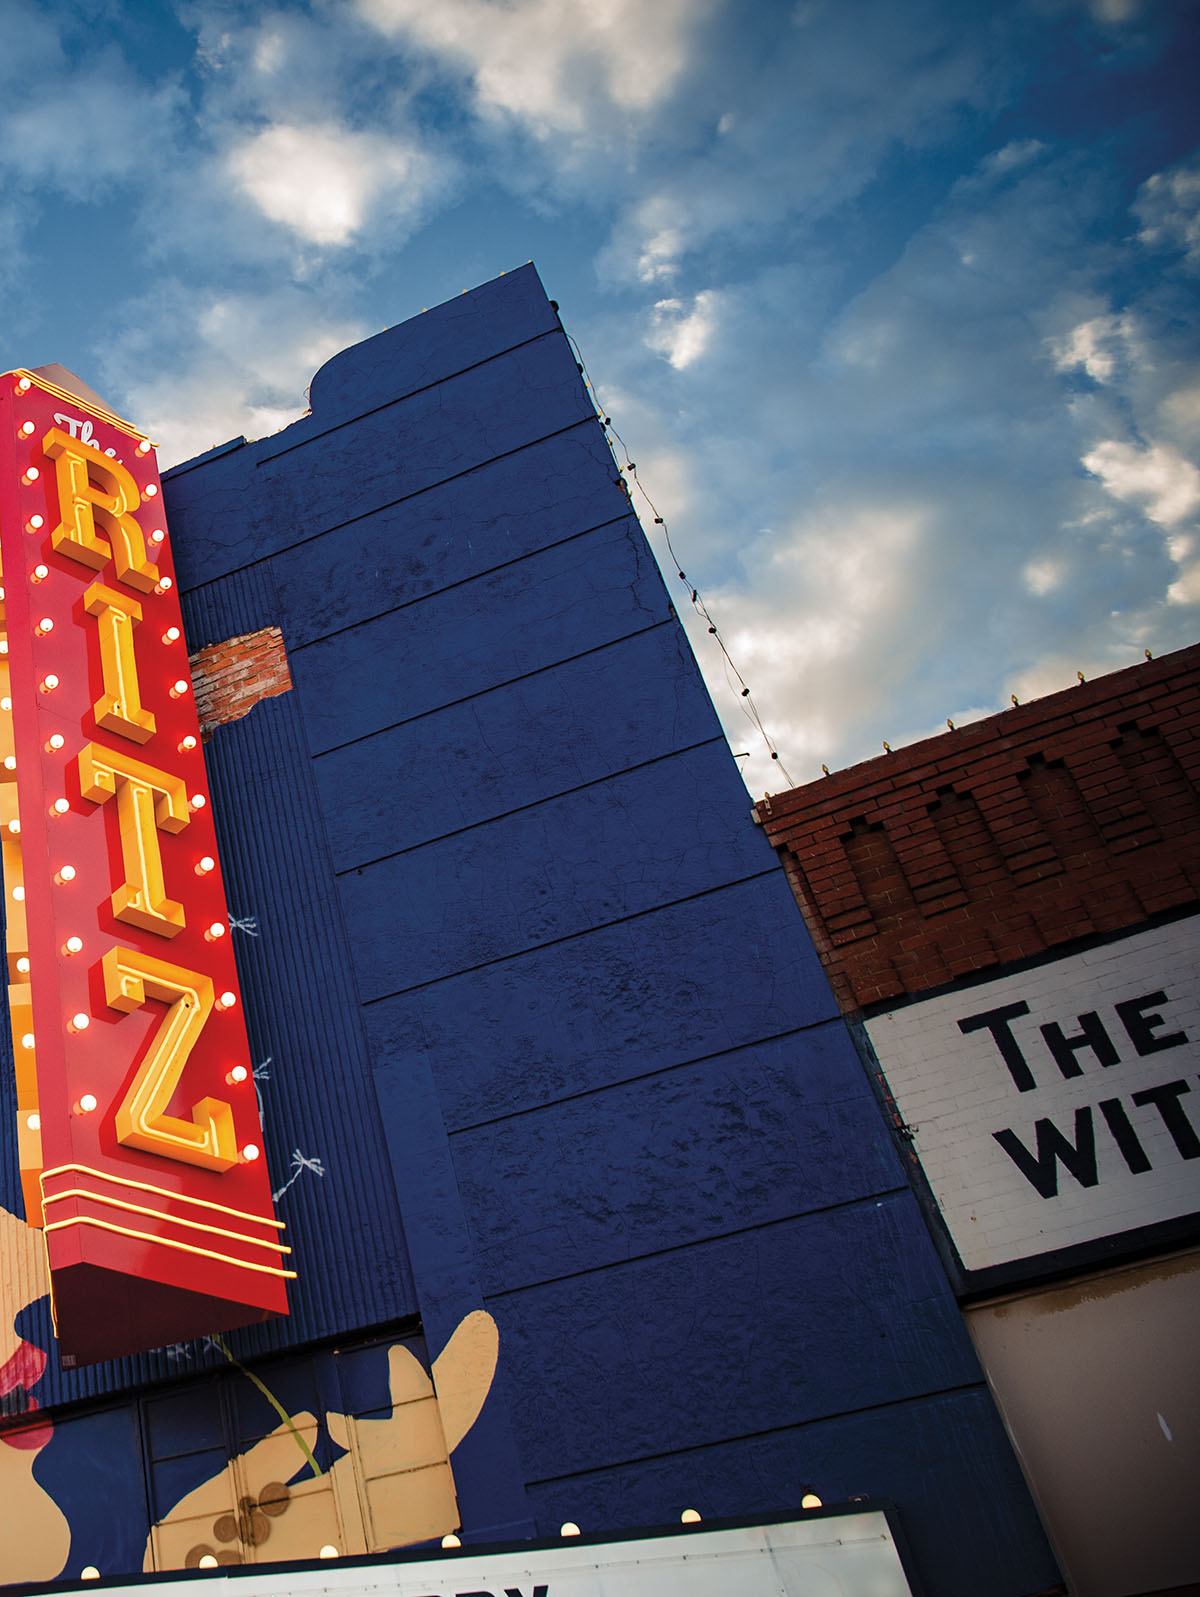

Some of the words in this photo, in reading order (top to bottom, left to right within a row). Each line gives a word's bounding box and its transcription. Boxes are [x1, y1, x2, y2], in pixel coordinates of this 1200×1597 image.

[42, 427, 238, 1172] RITZ
[957, 990, 1189, 1093] THE
[991, 1071, 1200, 1199] WIT
